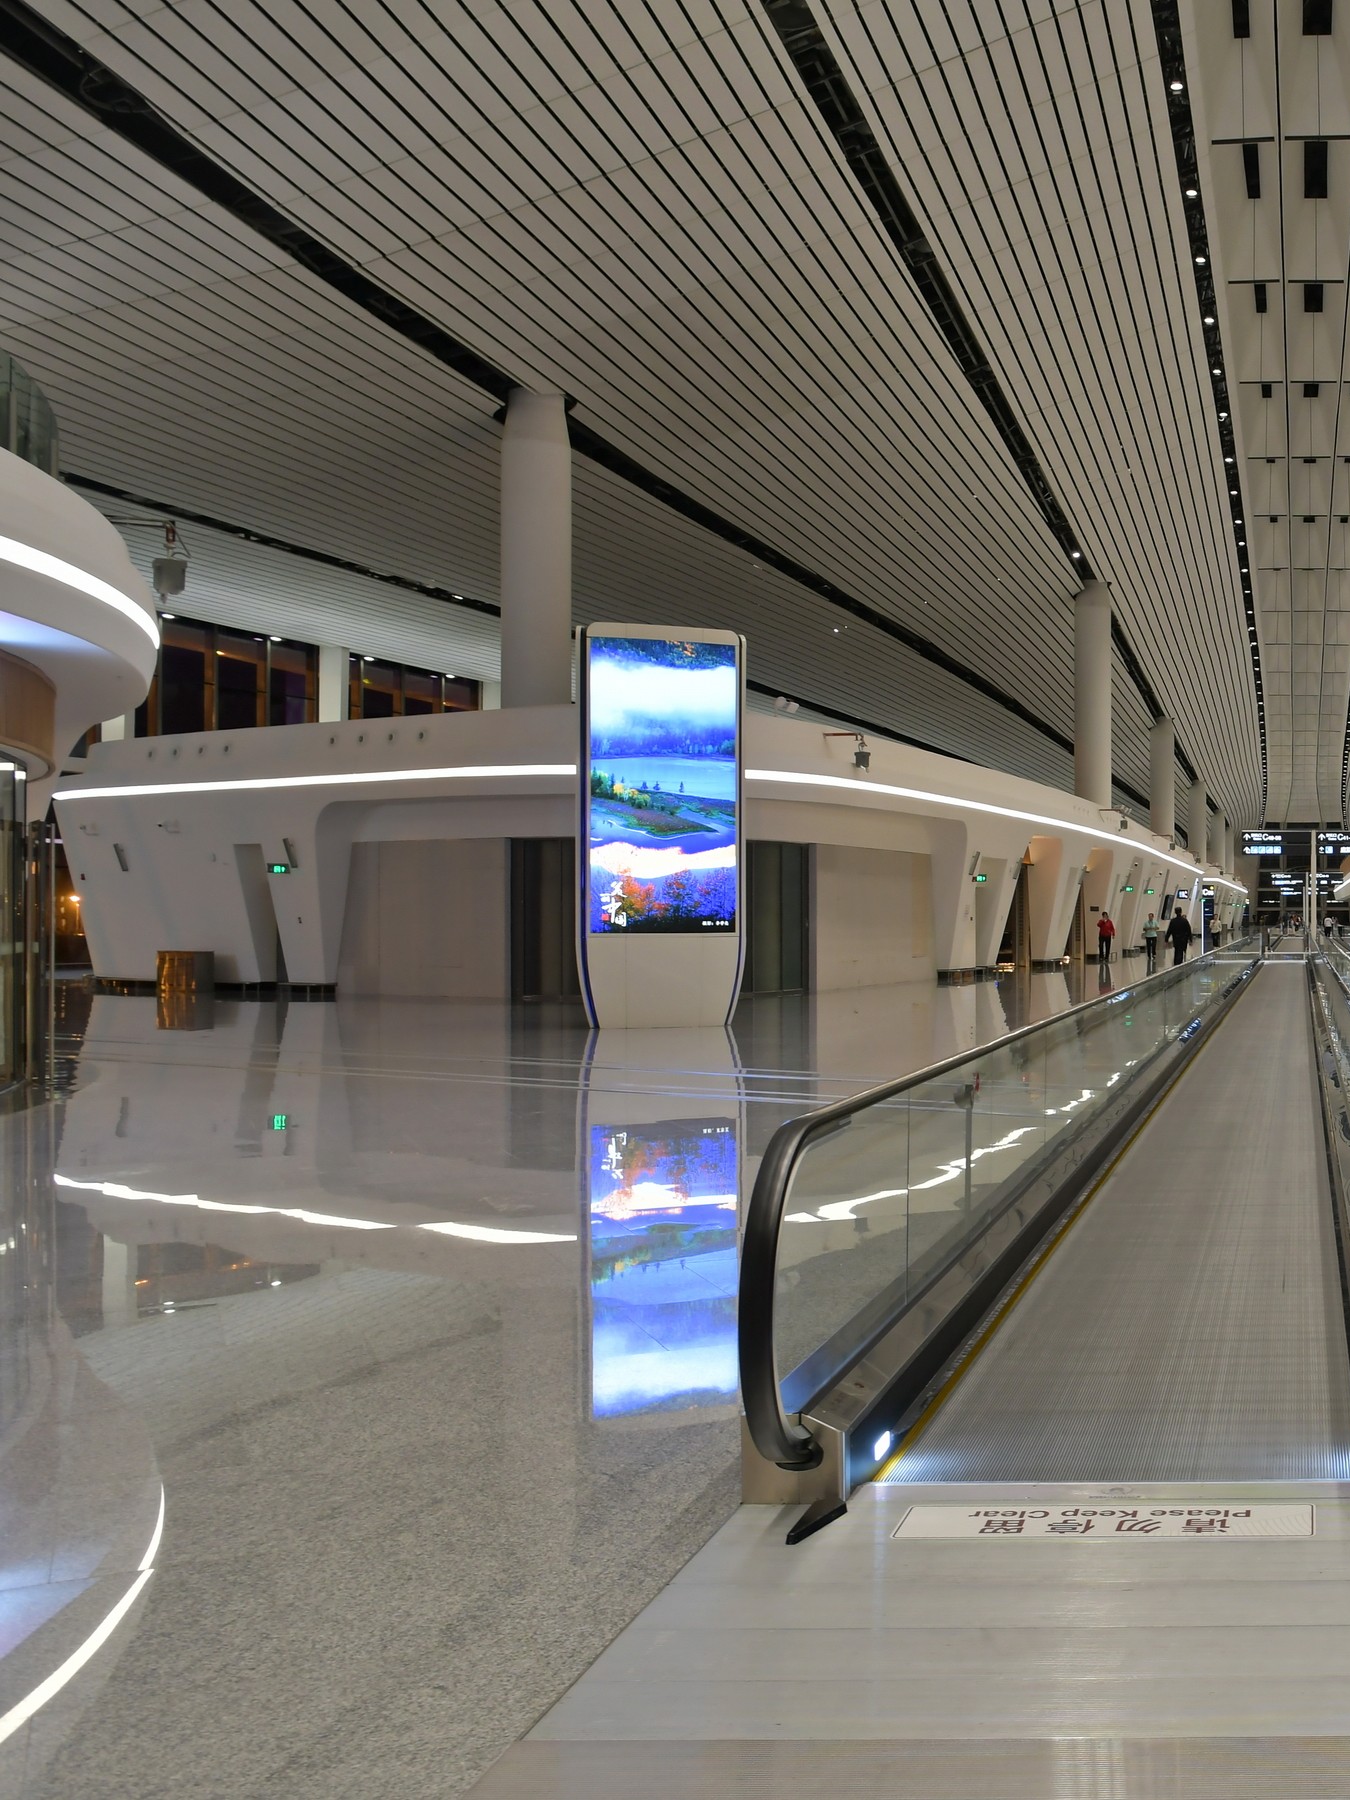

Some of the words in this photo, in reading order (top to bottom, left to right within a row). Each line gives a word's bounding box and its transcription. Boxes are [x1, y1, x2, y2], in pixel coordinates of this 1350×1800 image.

[968, 1509, 1051, 1519] Clear
[1060, 1509, 1139, 1519] Keep
[1149, 1509, 1252, 1519] Please
[978, 1518, 1231, 1534] 请勿停留
